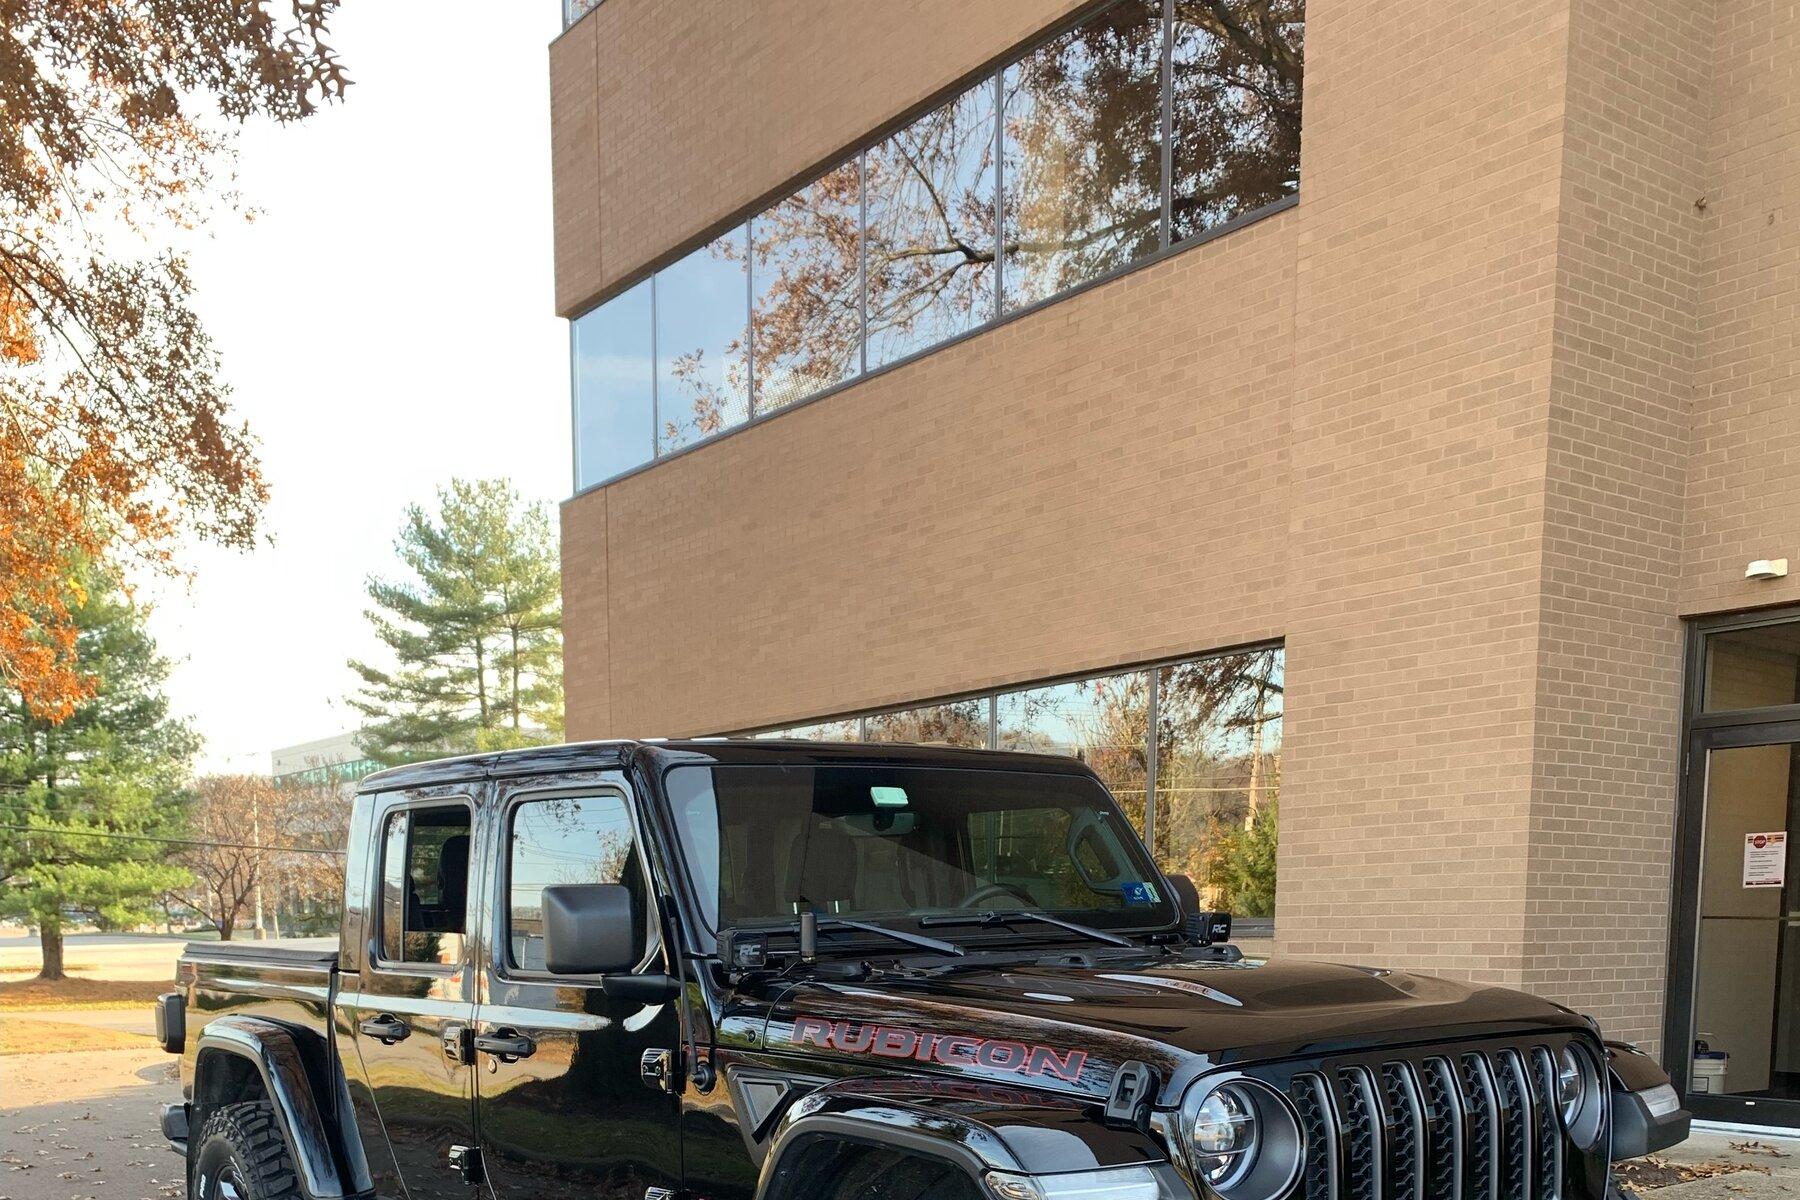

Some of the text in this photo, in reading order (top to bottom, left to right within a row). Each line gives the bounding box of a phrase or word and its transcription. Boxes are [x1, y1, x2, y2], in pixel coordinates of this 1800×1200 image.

[1212, 924, 1227, 933] RC
[739, 944, 761, 956] RC
[791, 1016, 1089, 1081] RUBICON
